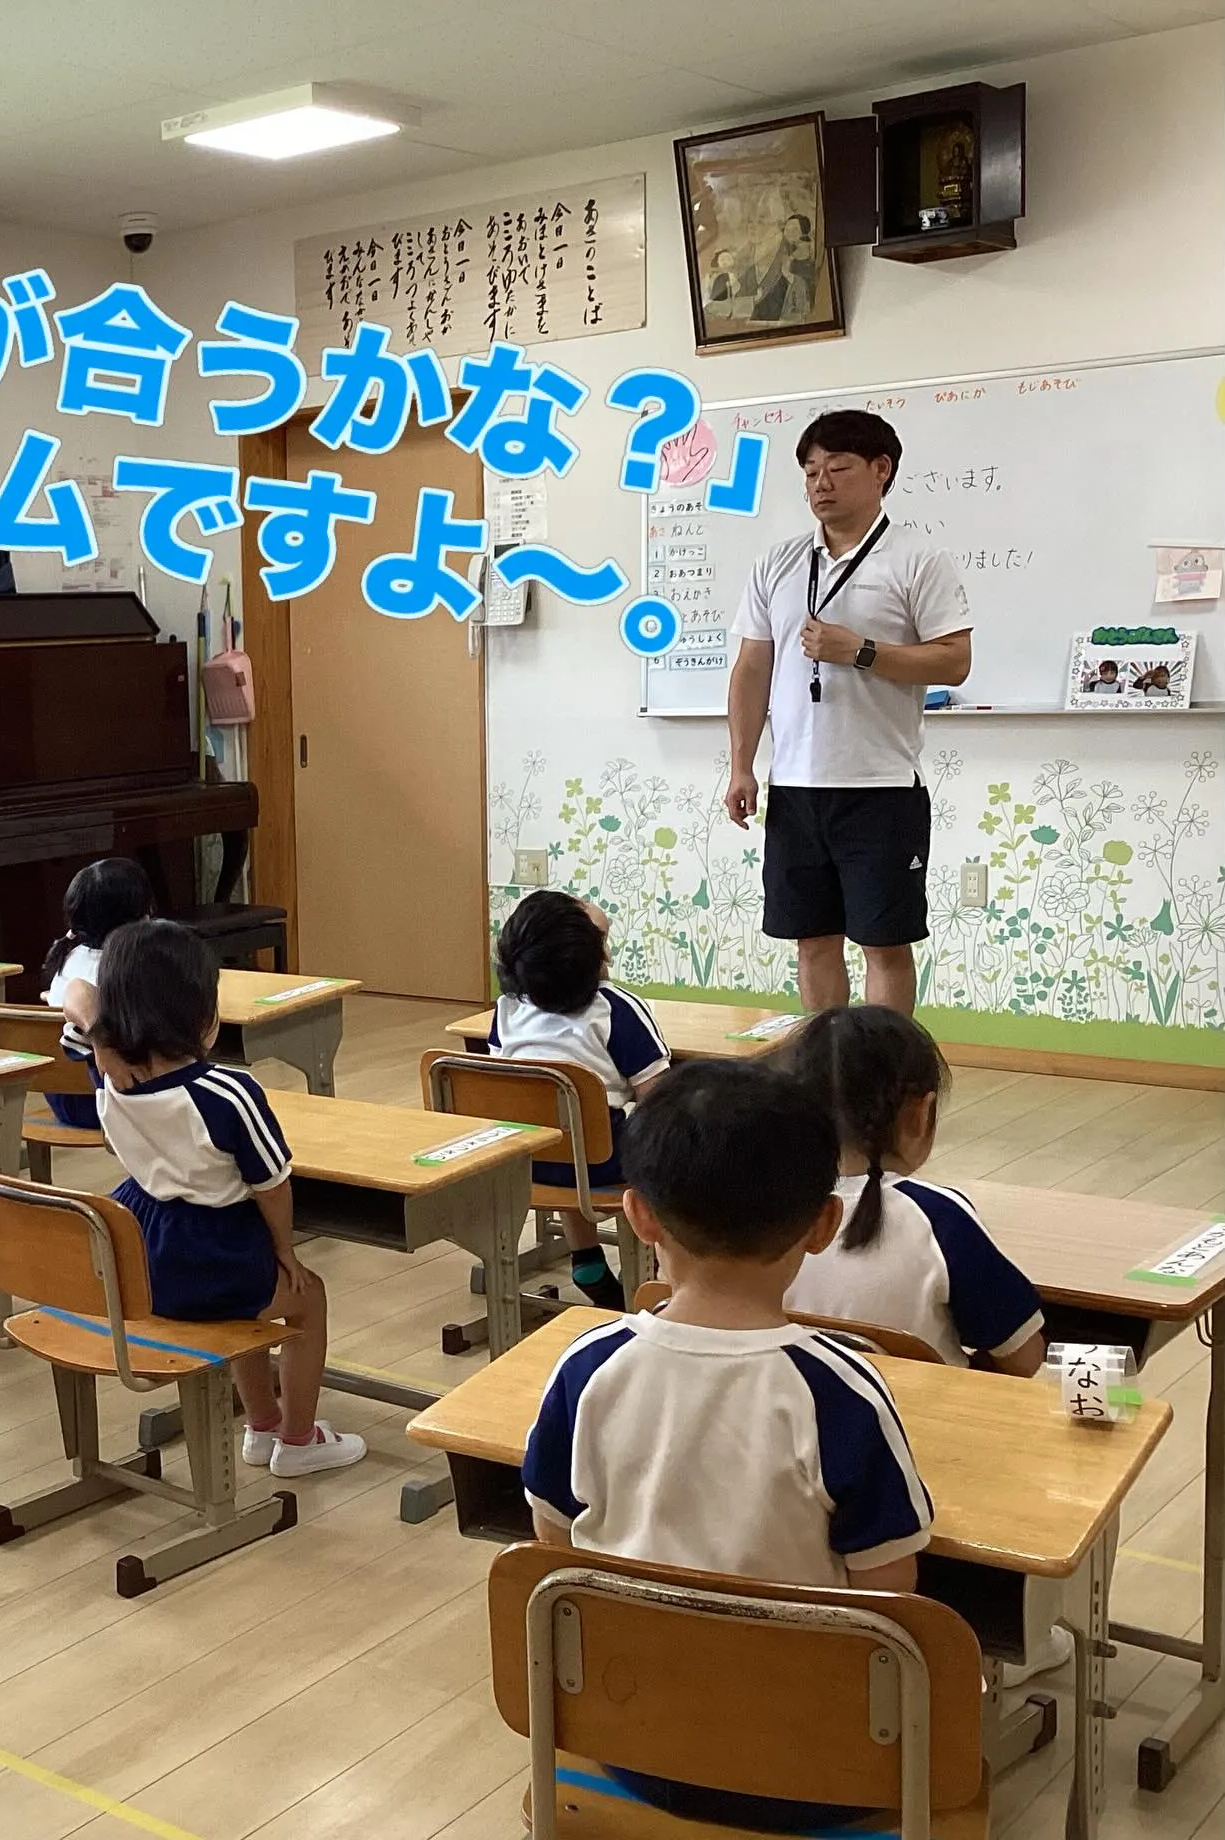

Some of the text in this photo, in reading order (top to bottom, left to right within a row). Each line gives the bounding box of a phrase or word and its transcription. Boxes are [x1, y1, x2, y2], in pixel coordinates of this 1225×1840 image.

[453, 217, 473, 283] 今日一日
[550, 201, 572, 270] 今日一日
[583, 198, 604, 326] あさのことば
[366, 236, 384, 303] 今日一日
[533, 206, 550, 336] みほとけさまを
[1017, 378, 1081, 396] もじあそび
[654, 567, 712, 579] 2 おあつまり
[956, 548, 1033, 570] りました！
